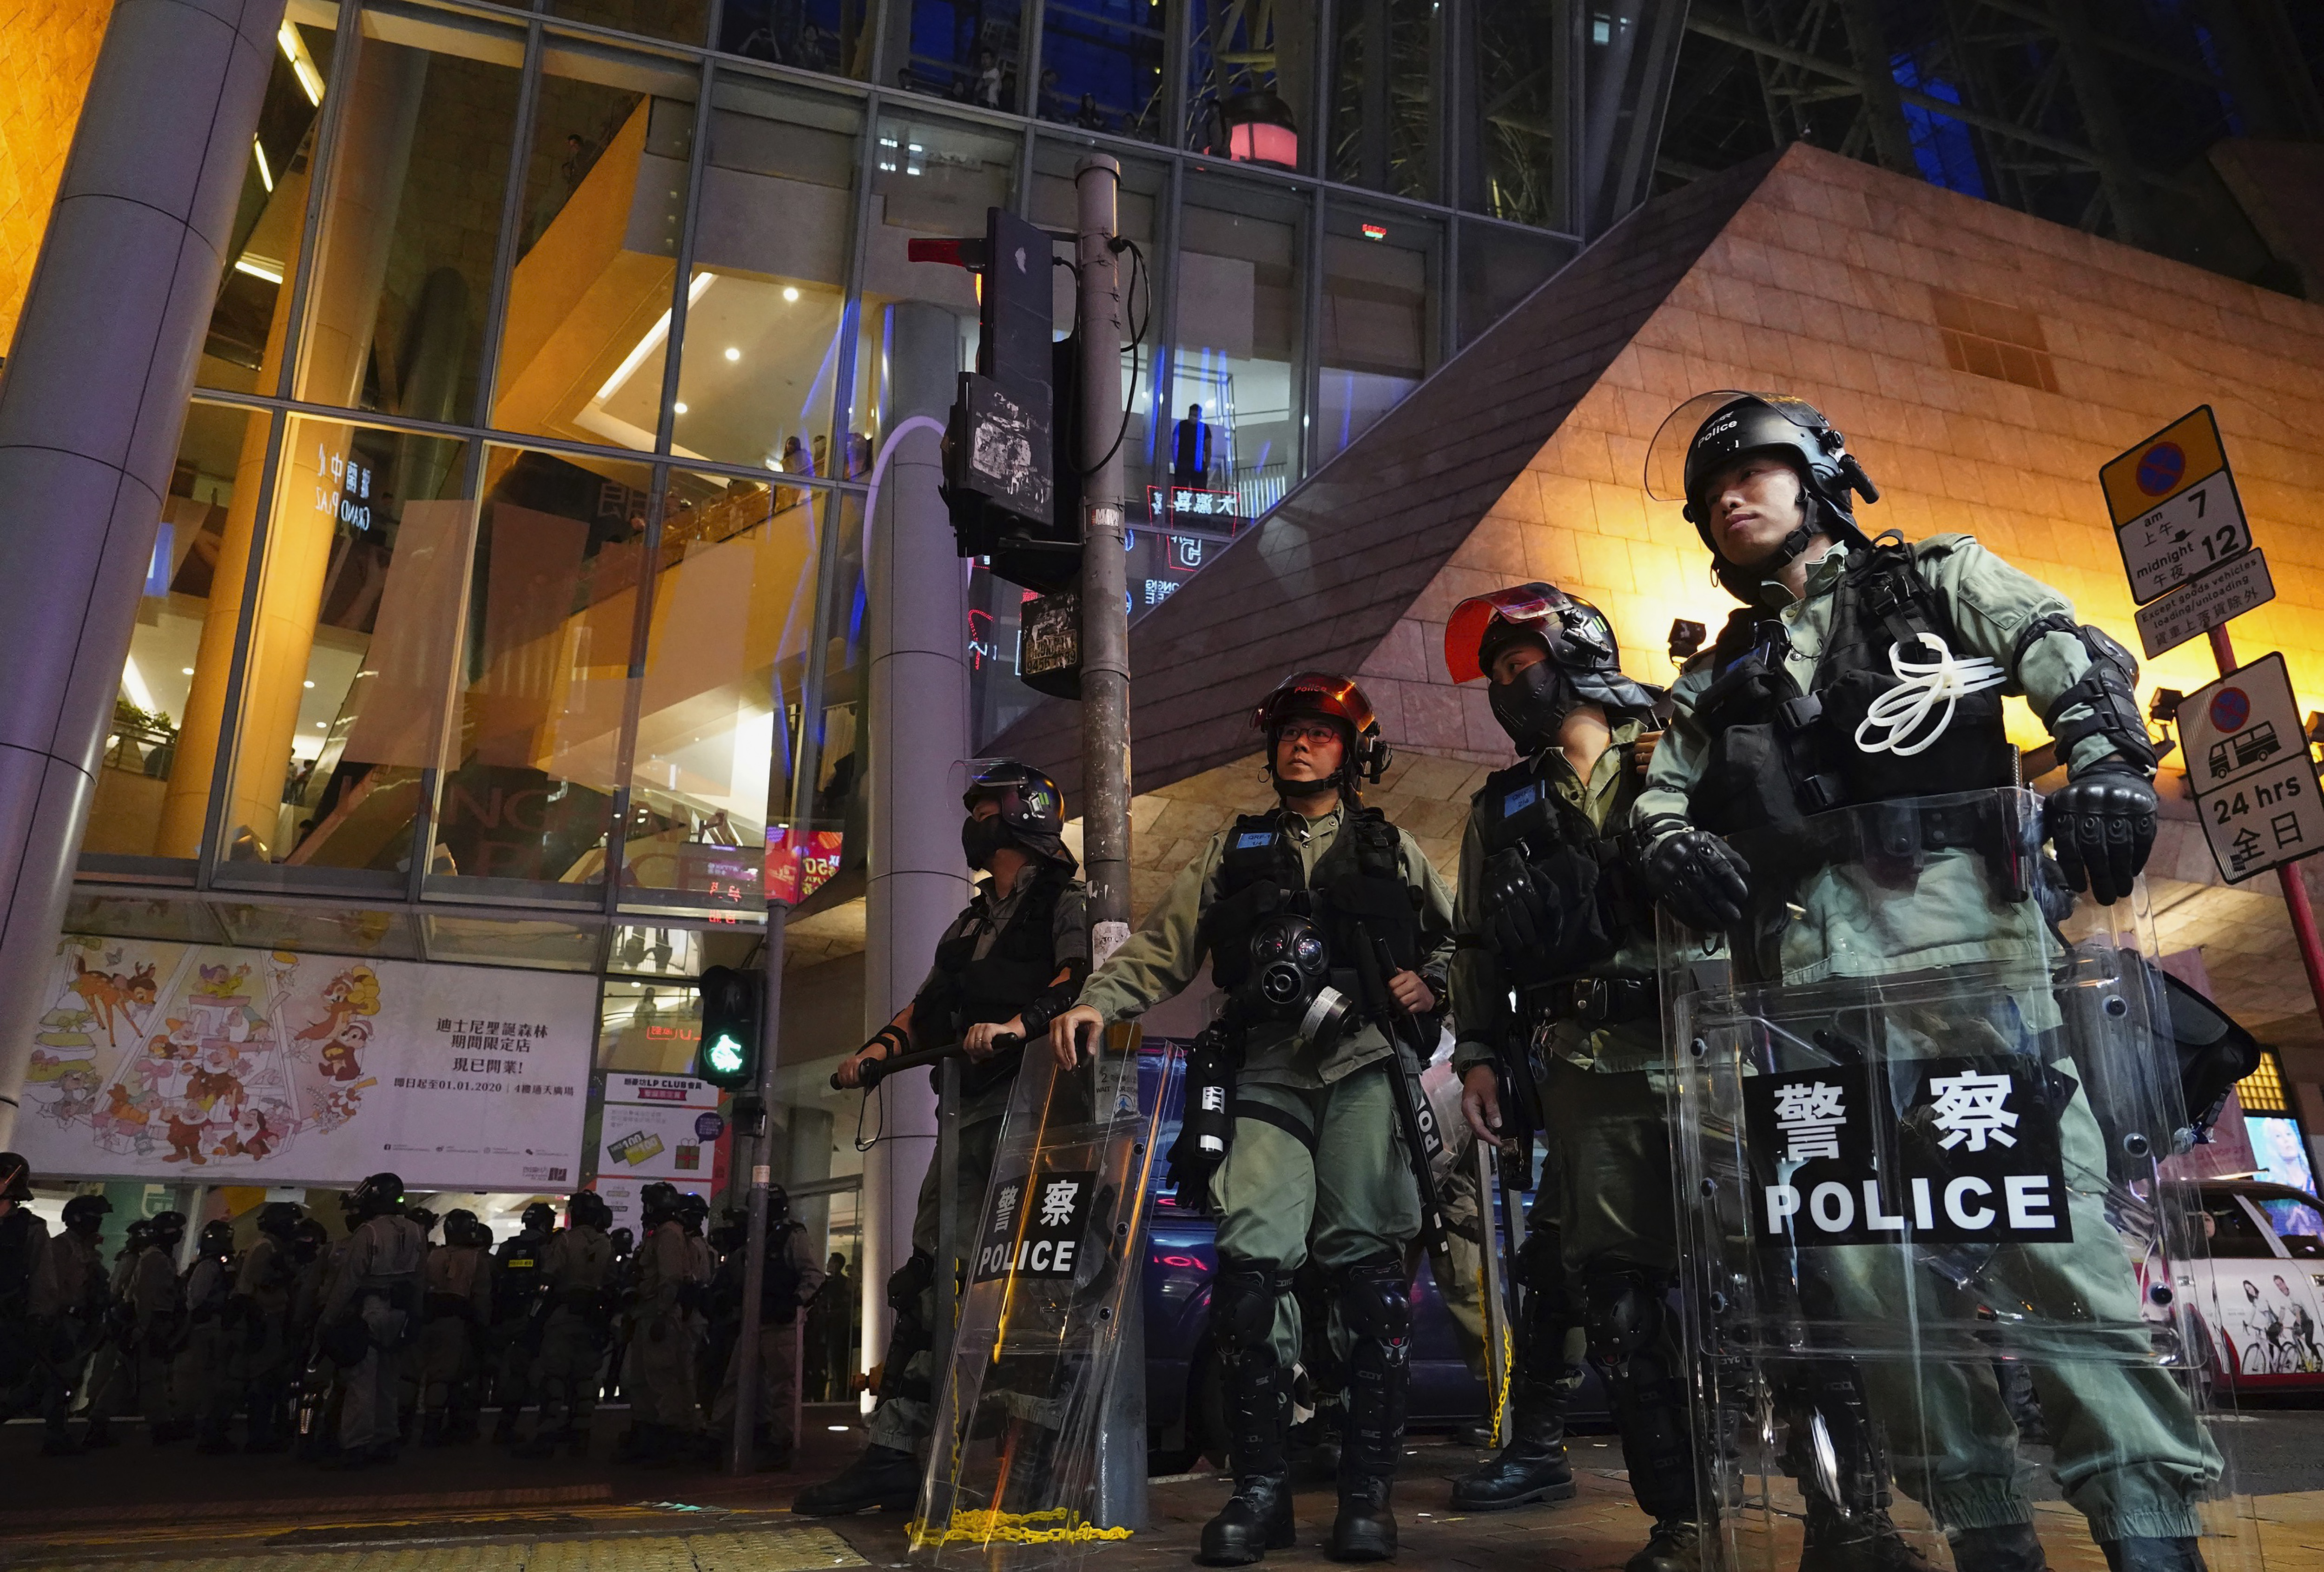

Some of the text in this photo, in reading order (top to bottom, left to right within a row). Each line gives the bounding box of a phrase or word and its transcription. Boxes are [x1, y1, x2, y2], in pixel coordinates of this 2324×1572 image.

[1698, 420, 1737, 448] Police
[2144, 489, 2206, 527] am 7
[2137, 525, 2239, 578] midnight 12
[2144, 522, 2173, 547] 上午
[2142, 559, 2258, 623] Except goods vehicles
[2153, 563, 2185, 587] 午夜
[2153, 575, 2249, 628] loading/unloading
[2213, 776, 2301, 825] 24 hrs
[2232, 811, 2303, 860] 全日
[436, 1017, 549, 1039] 迪士尼聖誕森林
[451, 1035, 531, 1053] 期間限定店
[453, 1057, 523, 1074] 現已開業!
[1774, 1070, 2019, 1162] 警察
[994, 1179, 1079, 1233] 警察
[1765, 1175, 2056, 1235] POLICE
[977, 1240, 1076, 1276] POLICE
